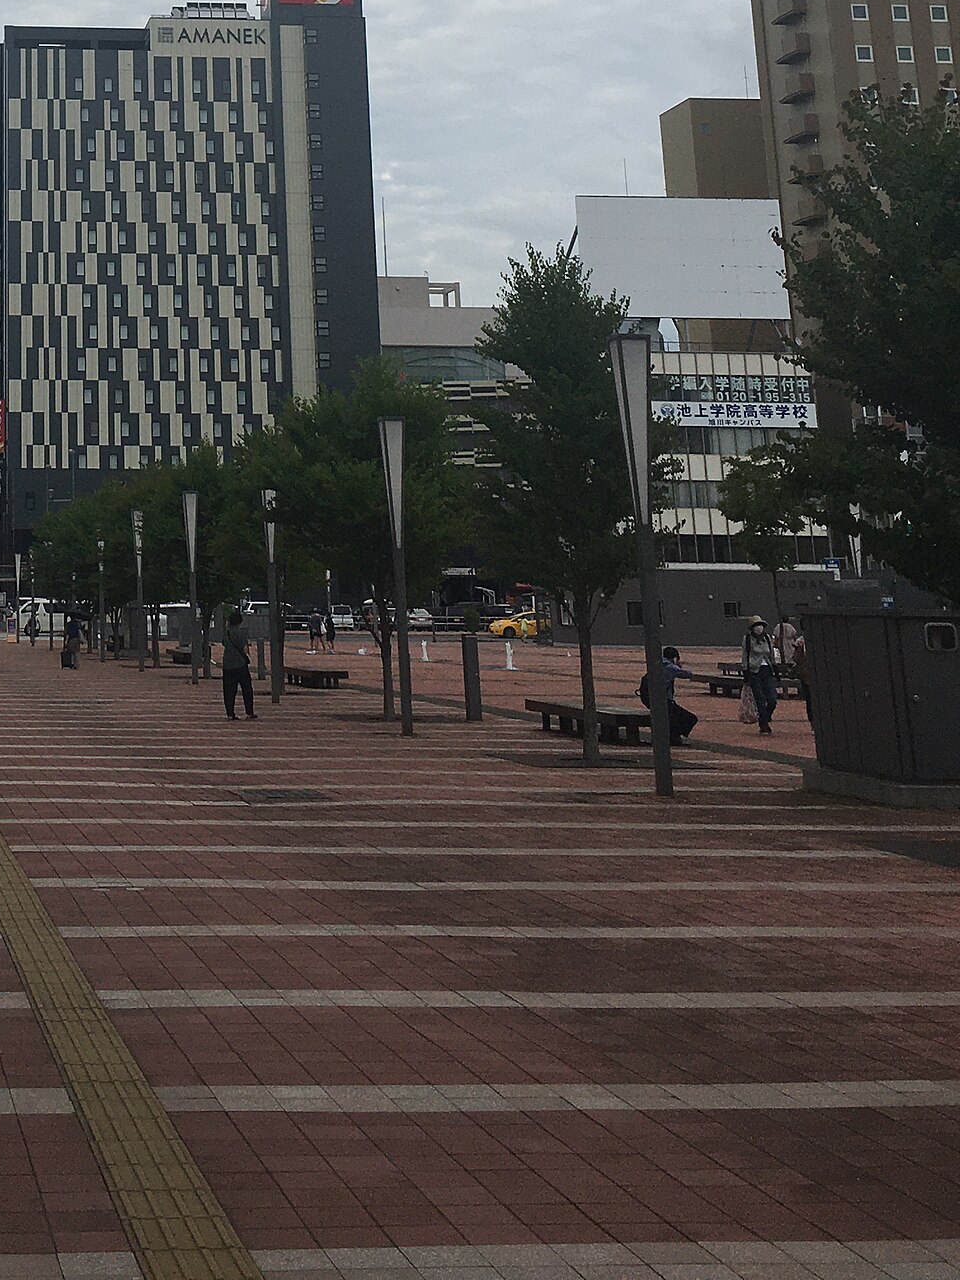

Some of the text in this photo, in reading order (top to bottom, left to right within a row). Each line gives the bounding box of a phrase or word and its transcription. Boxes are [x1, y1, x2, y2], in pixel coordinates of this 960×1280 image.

[177, 27, 266, 45] AMANEK
[667, 376, 809, 392] 学編入学随時受付中
[718, 391, 810, 402] 0120-195-315
[677, 403, 808, 419] 池上学院高等学校
